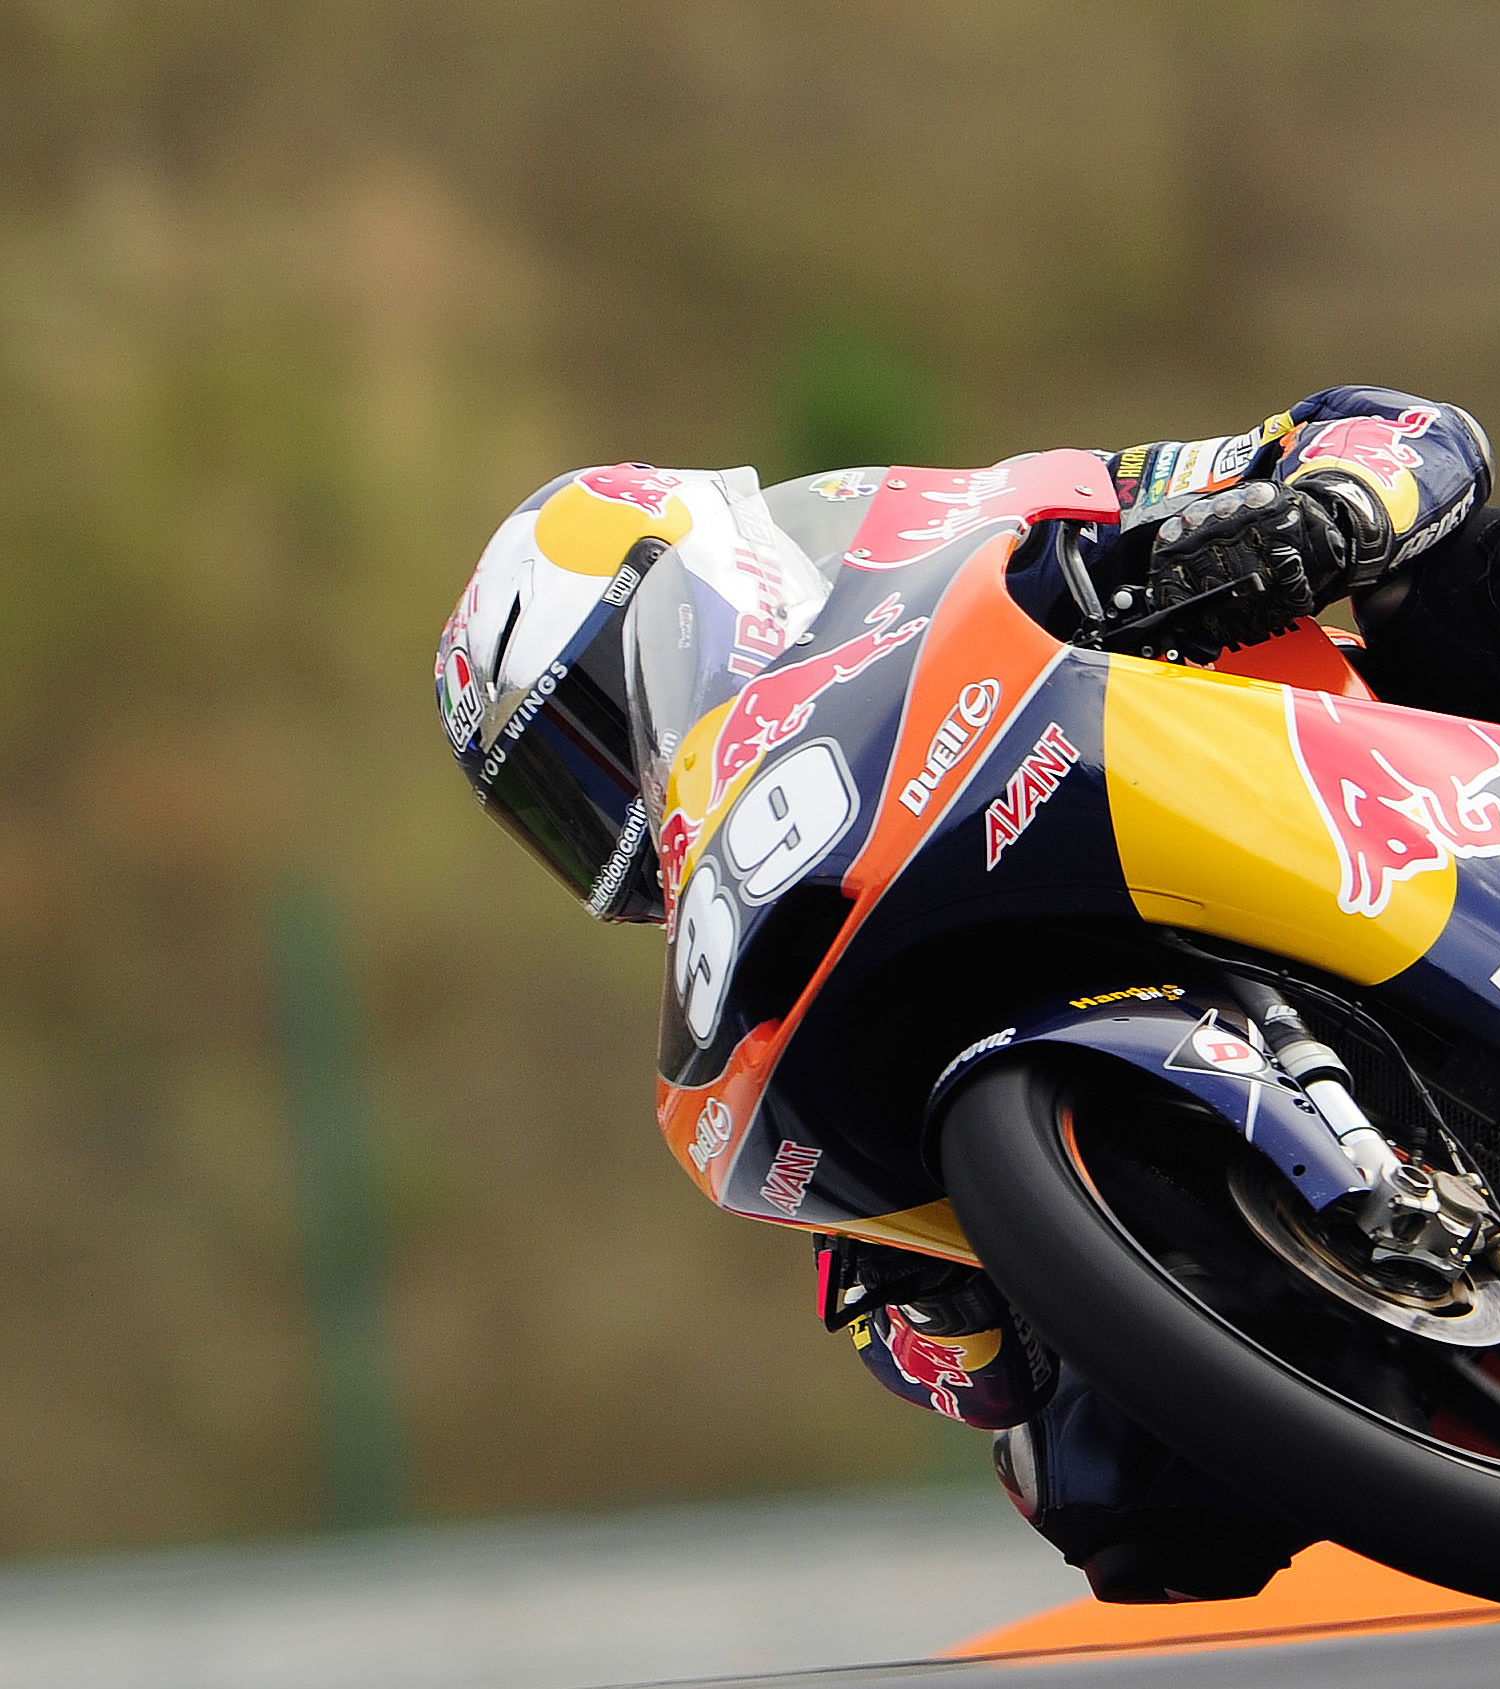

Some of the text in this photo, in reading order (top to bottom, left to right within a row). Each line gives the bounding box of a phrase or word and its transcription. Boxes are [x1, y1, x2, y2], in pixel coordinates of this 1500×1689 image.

[479, 659, 569, 786] YOU WINGS
[984, 721, 1081, 872] AVANT
[1069, 986, 1159, 1010] Handy
[760, 1139, 823, 1217] AVANT
